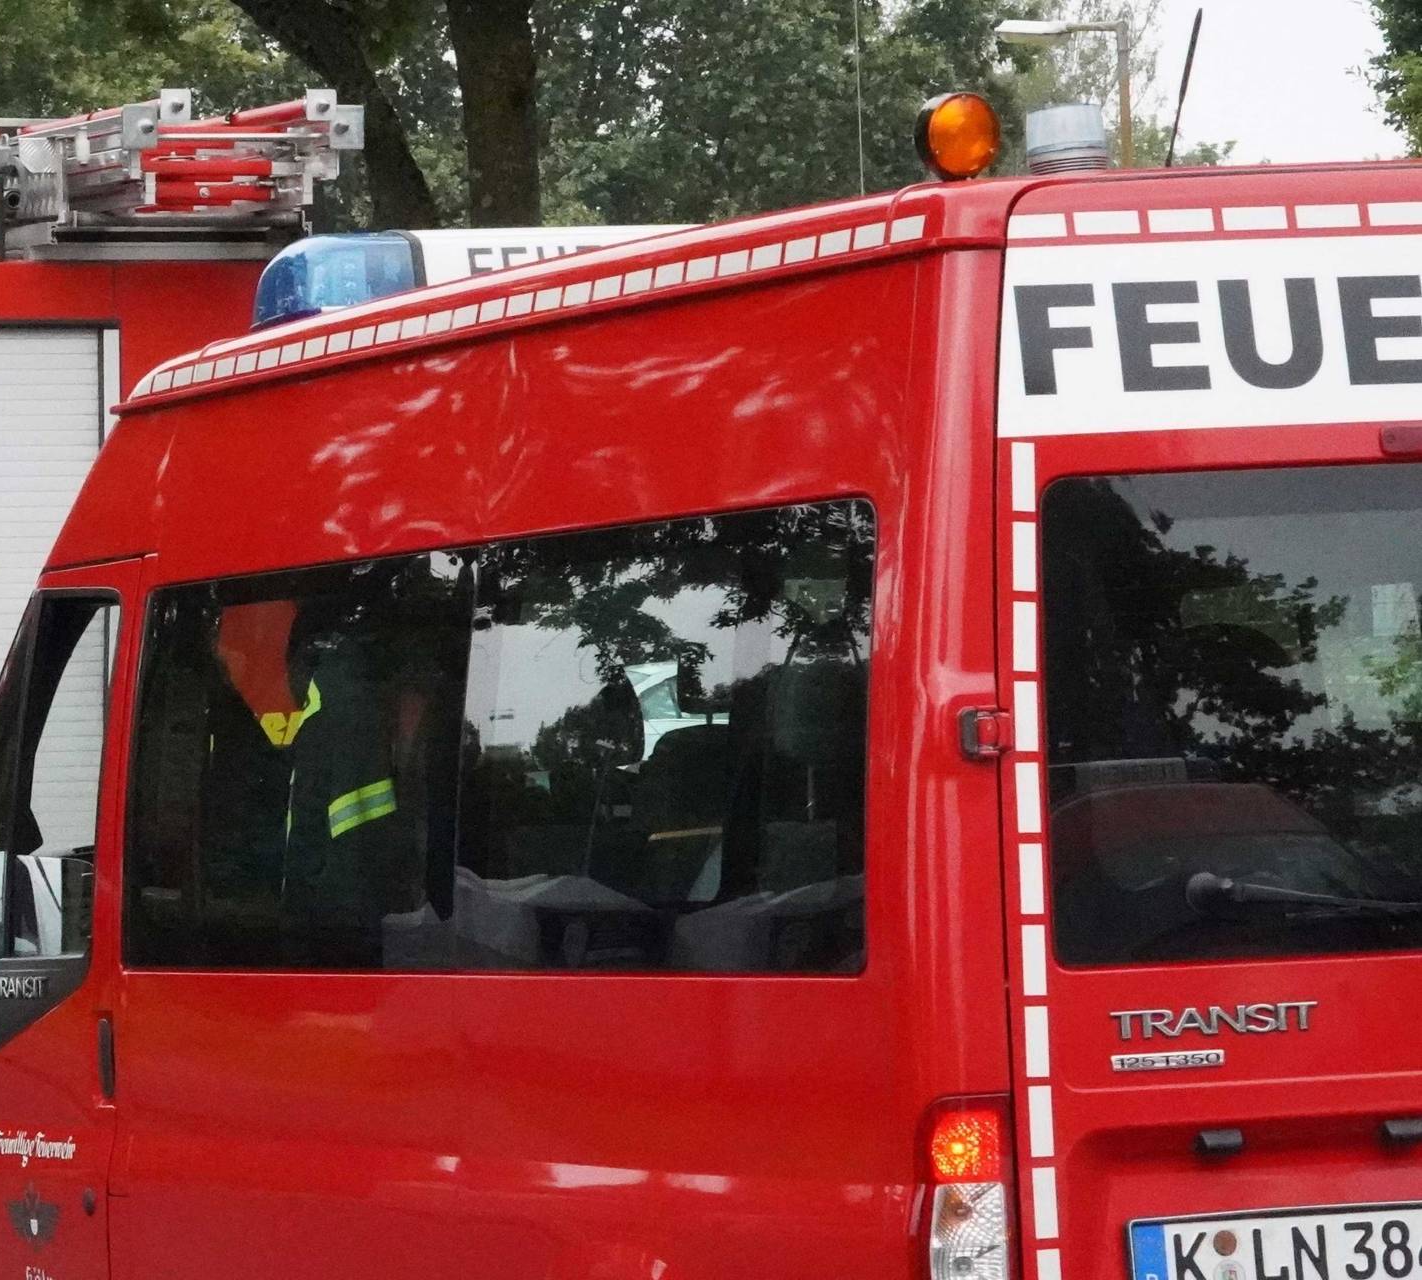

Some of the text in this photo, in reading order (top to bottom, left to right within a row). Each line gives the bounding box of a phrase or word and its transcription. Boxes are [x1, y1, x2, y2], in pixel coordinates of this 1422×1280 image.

[1013, 275, 1422, 396] FEUE
[1109, 1001, 1318, 1040] TRANSIT
[1115, 1052, 1221, 1069] 125 T350
[1173, 1219, 1422, 1280] K LN 38
